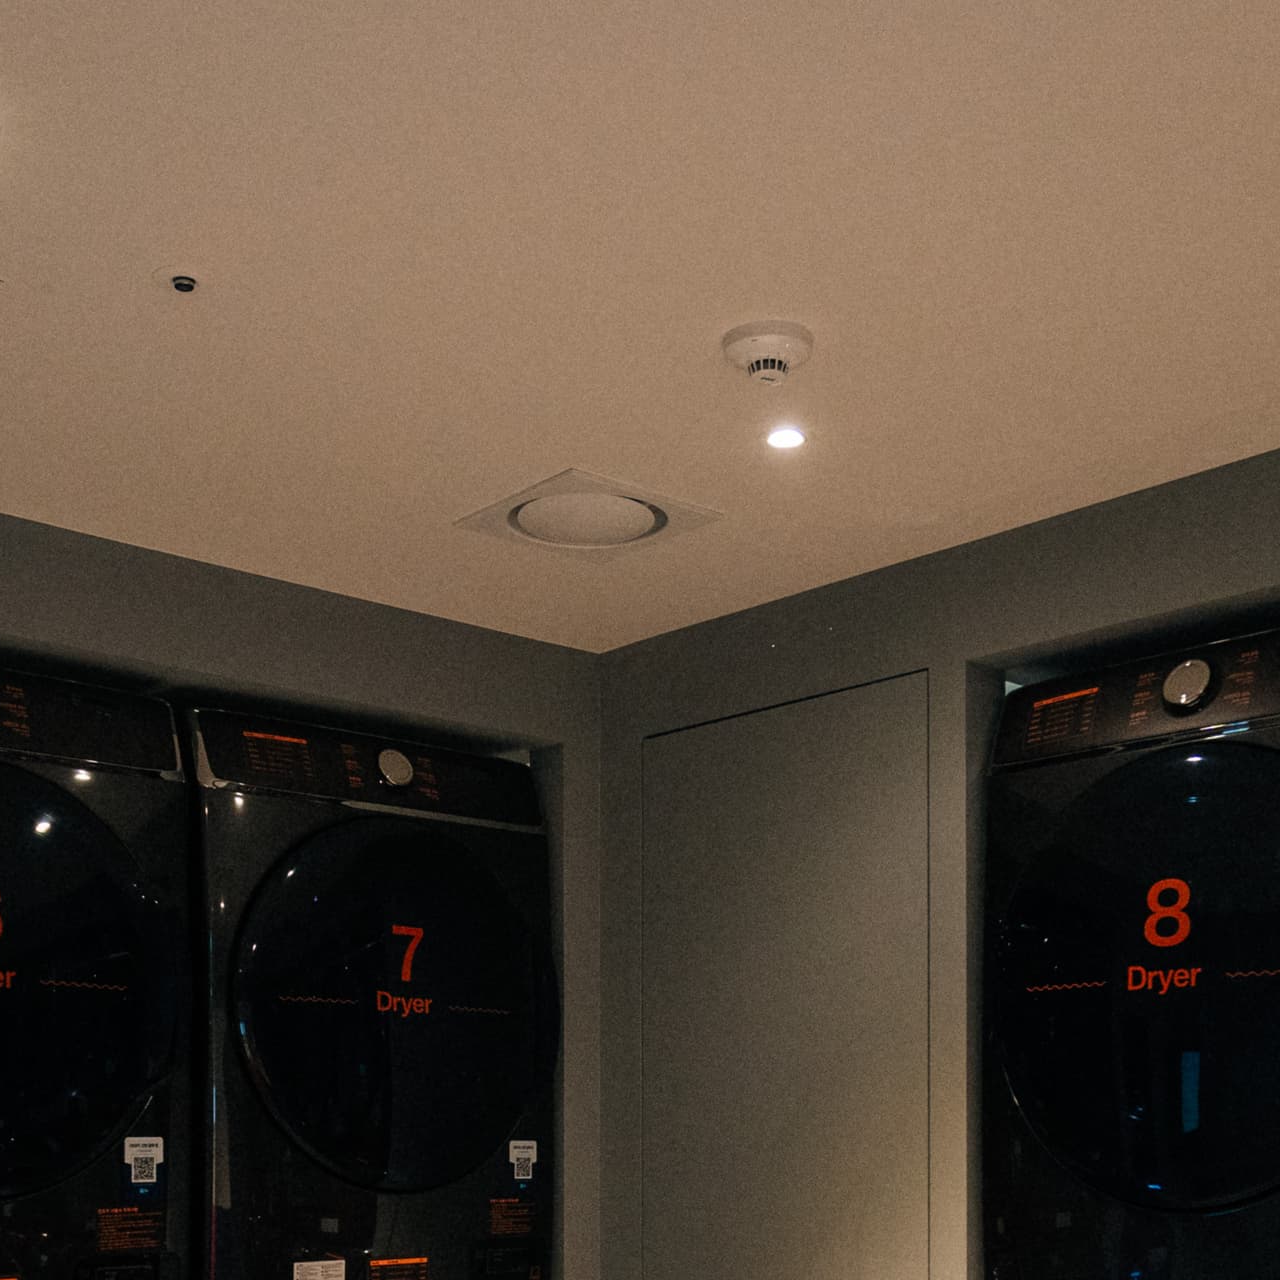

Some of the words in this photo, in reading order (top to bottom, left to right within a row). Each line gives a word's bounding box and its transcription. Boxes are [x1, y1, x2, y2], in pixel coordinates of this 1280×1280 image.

[1144, 877, 1192, 948] 8
[391, 924, 424, 983] 7
[1126, 964, 1202, 996] Dryer
[375, 990, 433, 1018] Dryer
